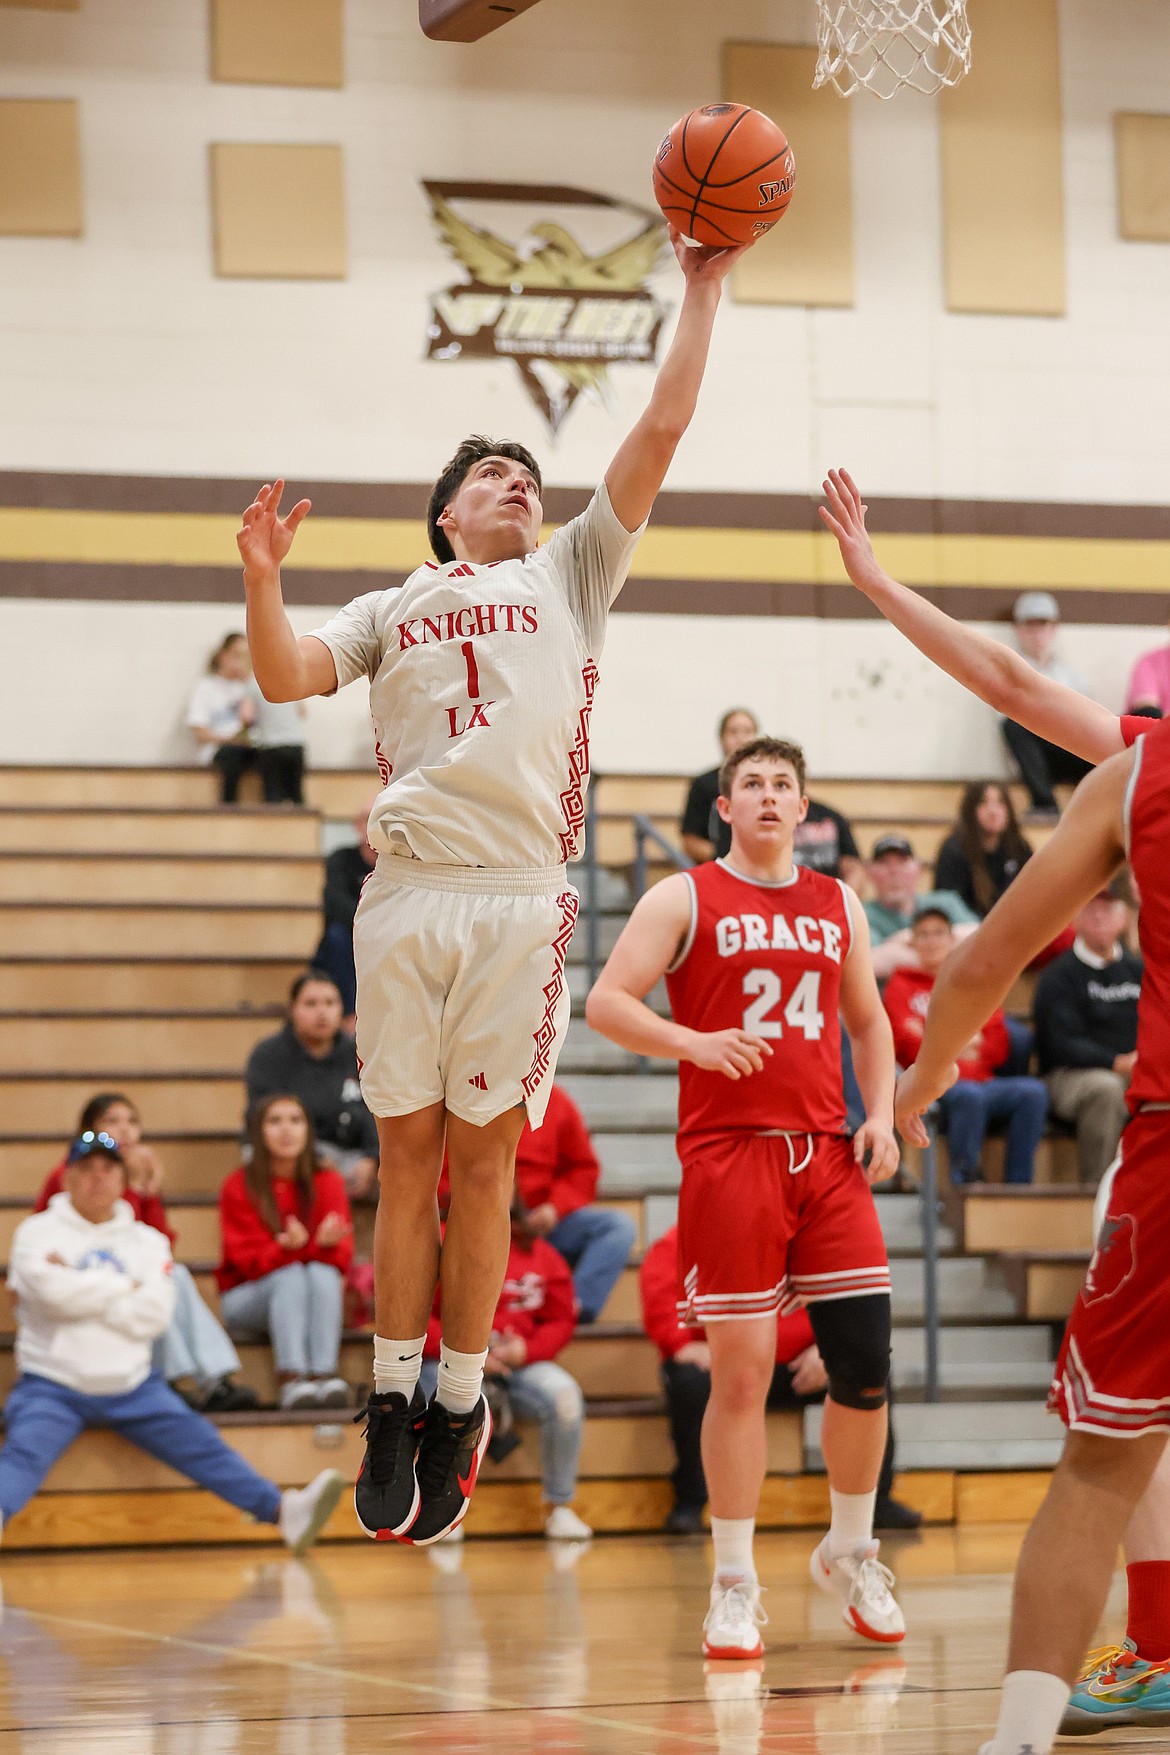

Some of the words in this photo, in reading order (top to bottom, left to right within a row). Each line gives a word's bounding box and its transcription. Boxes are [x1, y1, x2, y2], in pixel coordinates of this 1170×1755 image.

[396, 605, 538, 651] KNIGHTS
[461, 641, 480, 698] 1
[445, 700, 496, 738] LK
[715, 914, 842, 965] GRACE
[742, 968, 825, 1040] 24
